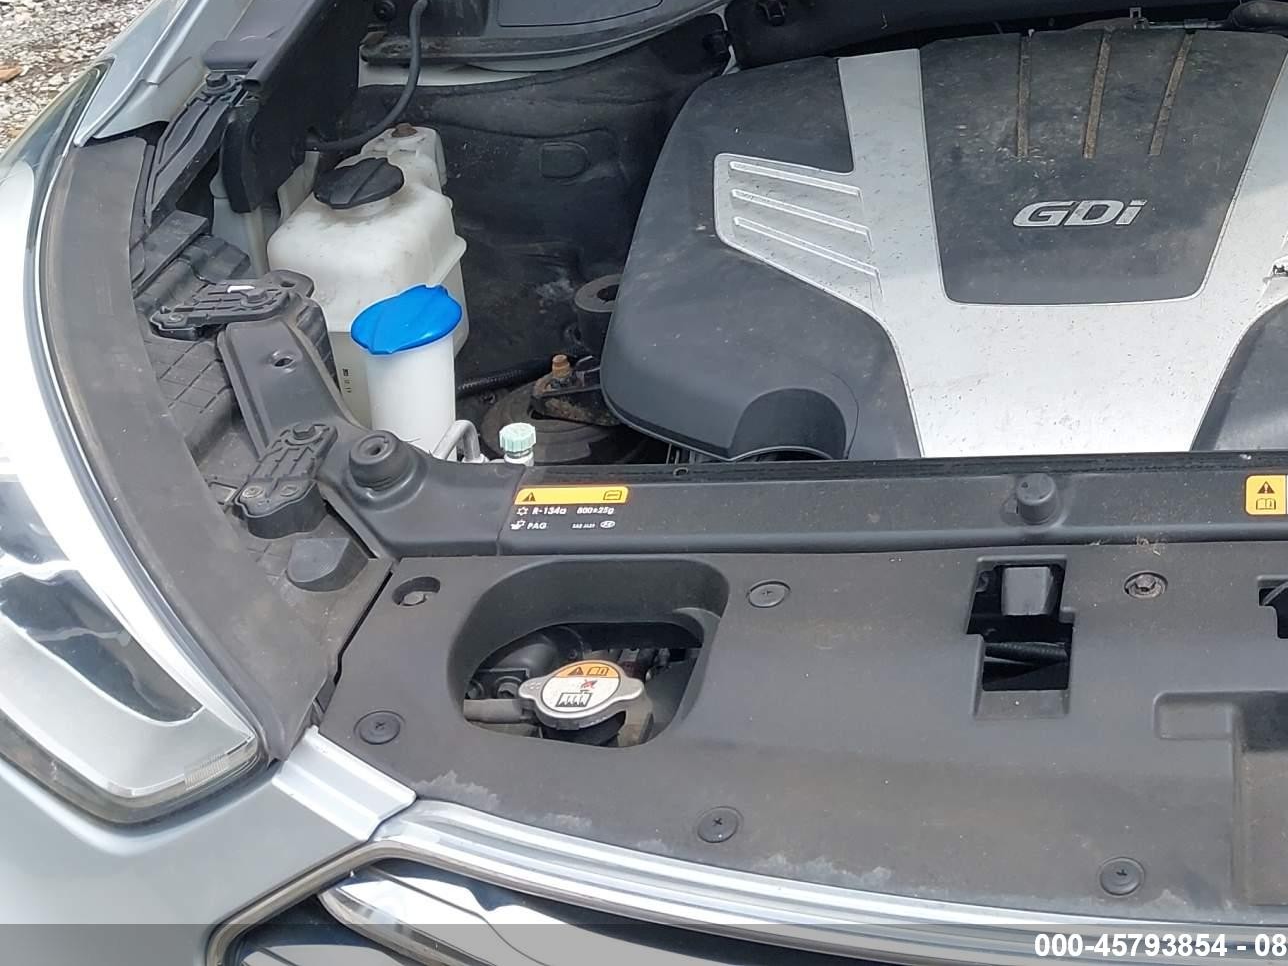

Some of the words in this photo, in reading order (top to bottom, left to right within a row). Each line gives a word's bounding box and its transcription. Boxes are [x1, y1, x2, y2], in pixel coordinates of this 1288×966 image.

[1012, 199, 1149, 227] GDi
[531, 506, 567, 515] R-134a
[527, 522, 548, 530] PAG
